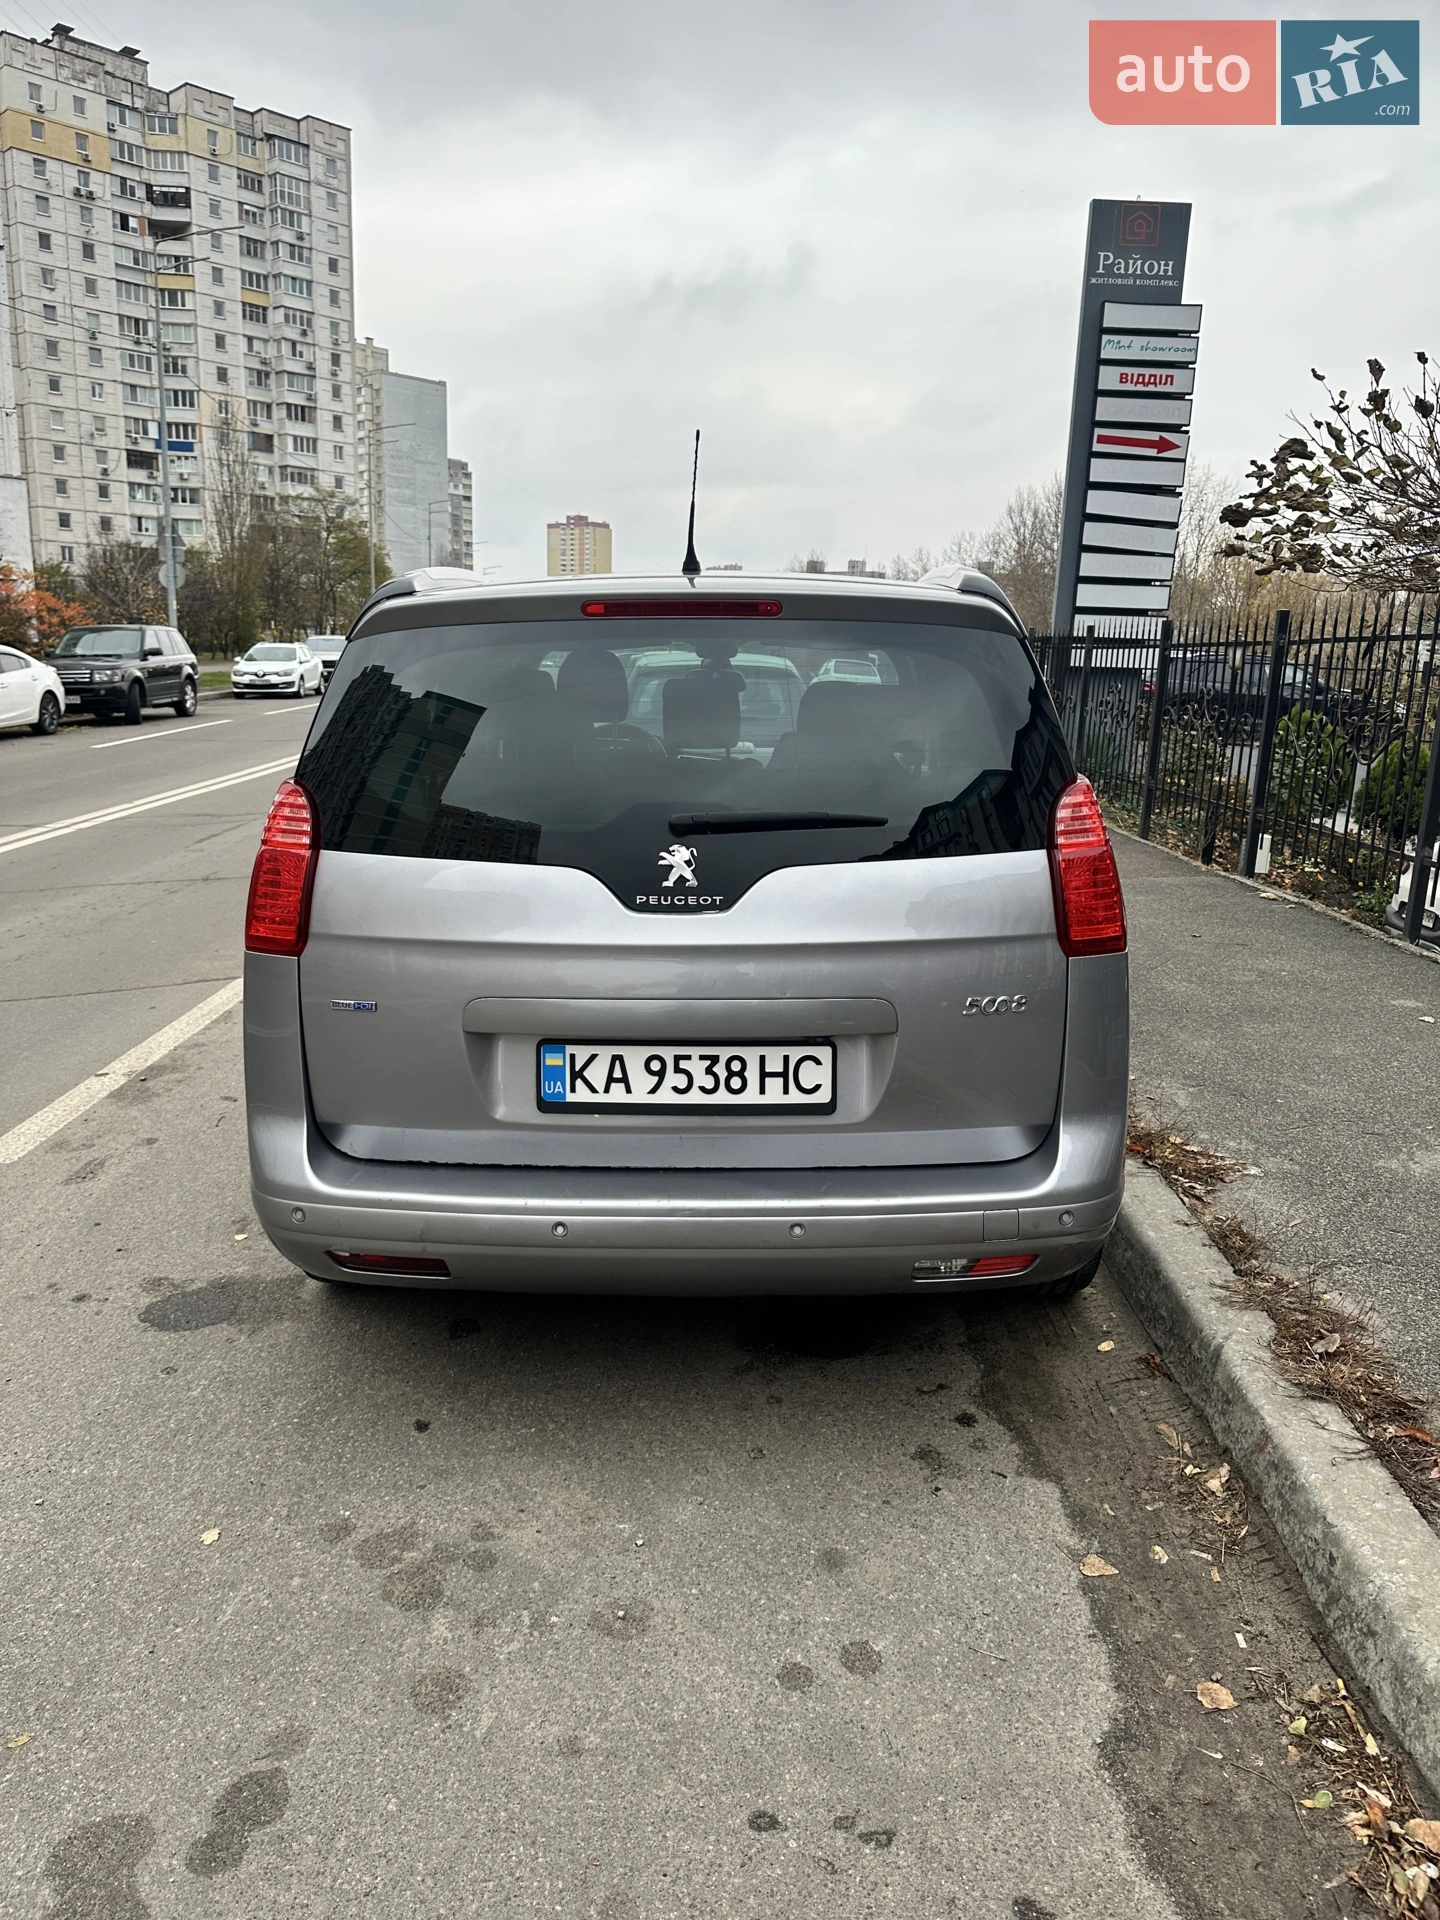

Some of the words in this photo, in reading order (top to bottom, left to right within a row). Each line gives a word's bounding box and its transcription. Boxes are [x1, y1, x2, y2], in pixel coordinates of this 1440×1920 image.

[1096, 251, 1174, 276] Район
[1089, 277, 1134, 285] житловий
[1136, 279, 1179, 287] комплекс
[1102, 338, 1133, 351] Mint
[1140, 341, 1196, 355] showroom
[1118, 372, 1175, 388] ВІДДІЛ
[636, 895, 724, 905] PEUGEOT
[962, 994, 1029, 1016] 5008
[569, 1053, 632, 1095] KA
[644, 1053, 748, 1095] 9538
[758, 1054, 823, 1095] HC
[545, 1080, 564, 1094] UA
